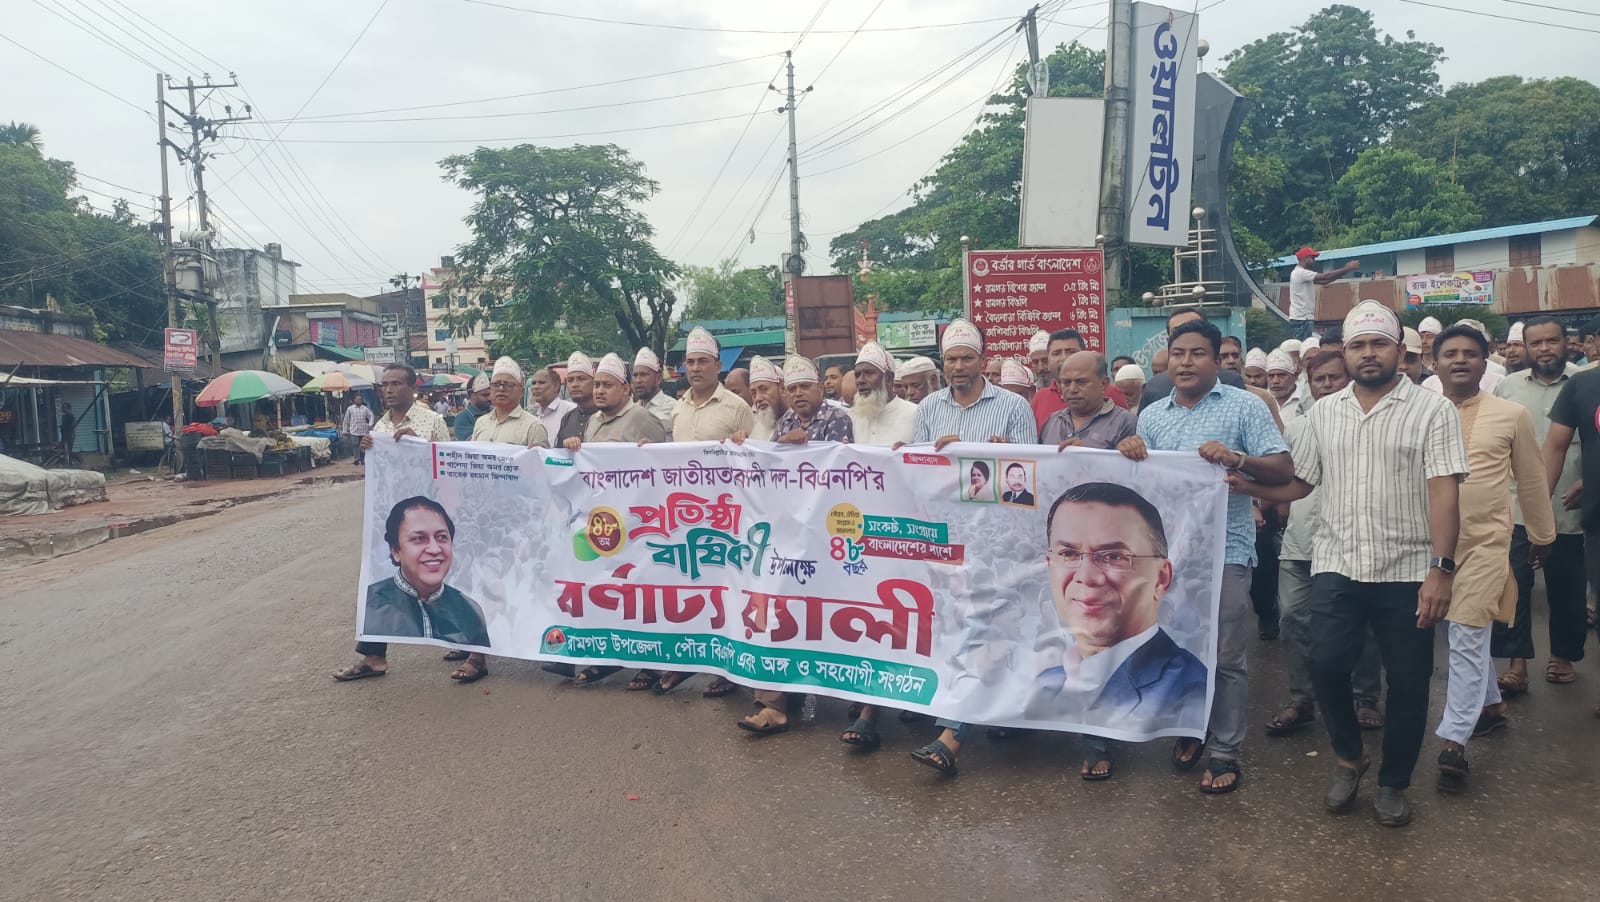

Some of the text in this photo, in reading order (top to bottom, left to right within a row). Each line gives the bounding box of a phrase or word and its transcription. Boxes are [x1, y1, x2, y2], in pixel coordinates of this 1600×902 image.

[1146, 21, 1180, 232] ওয়ালটন
[991, 255, 1082, 271] বর্ডার গার্ড বাংলাদেশ
[579, 467, 657, 490] বাংলাদেশ
[661, 460, 765, 489] জাতীয়তাবাদী
[591, 517, 618, 537] ৪৮
[628, 491, 742, 541] প্রতিষ্ঠা
[597, 536, 611, 547] তম
[646, 521, 771, 581] বার্ষিকী
[830, 536, 865, 561] ৪৮
[867, 538, 953, 561] বাংলাদেশের পাশে
[769, 548, 819, 585] উপলক্ষে
[843, 558, 869, 577] বছর
[554, 562, 936, 658] বর্ণাঢ্য র‍্যালী
[567, 633, 608, 656] রামগড়
[674, 638, 707, 659] পৌর
[737, 650, 757, 675] এবং
[760, 655, 791, 677] অঙ্গ
[797, 660, 810, 676] ও
[815, 658, 875, 688] সহযোগী
[877, 667, 927, 697] সংগঠন
